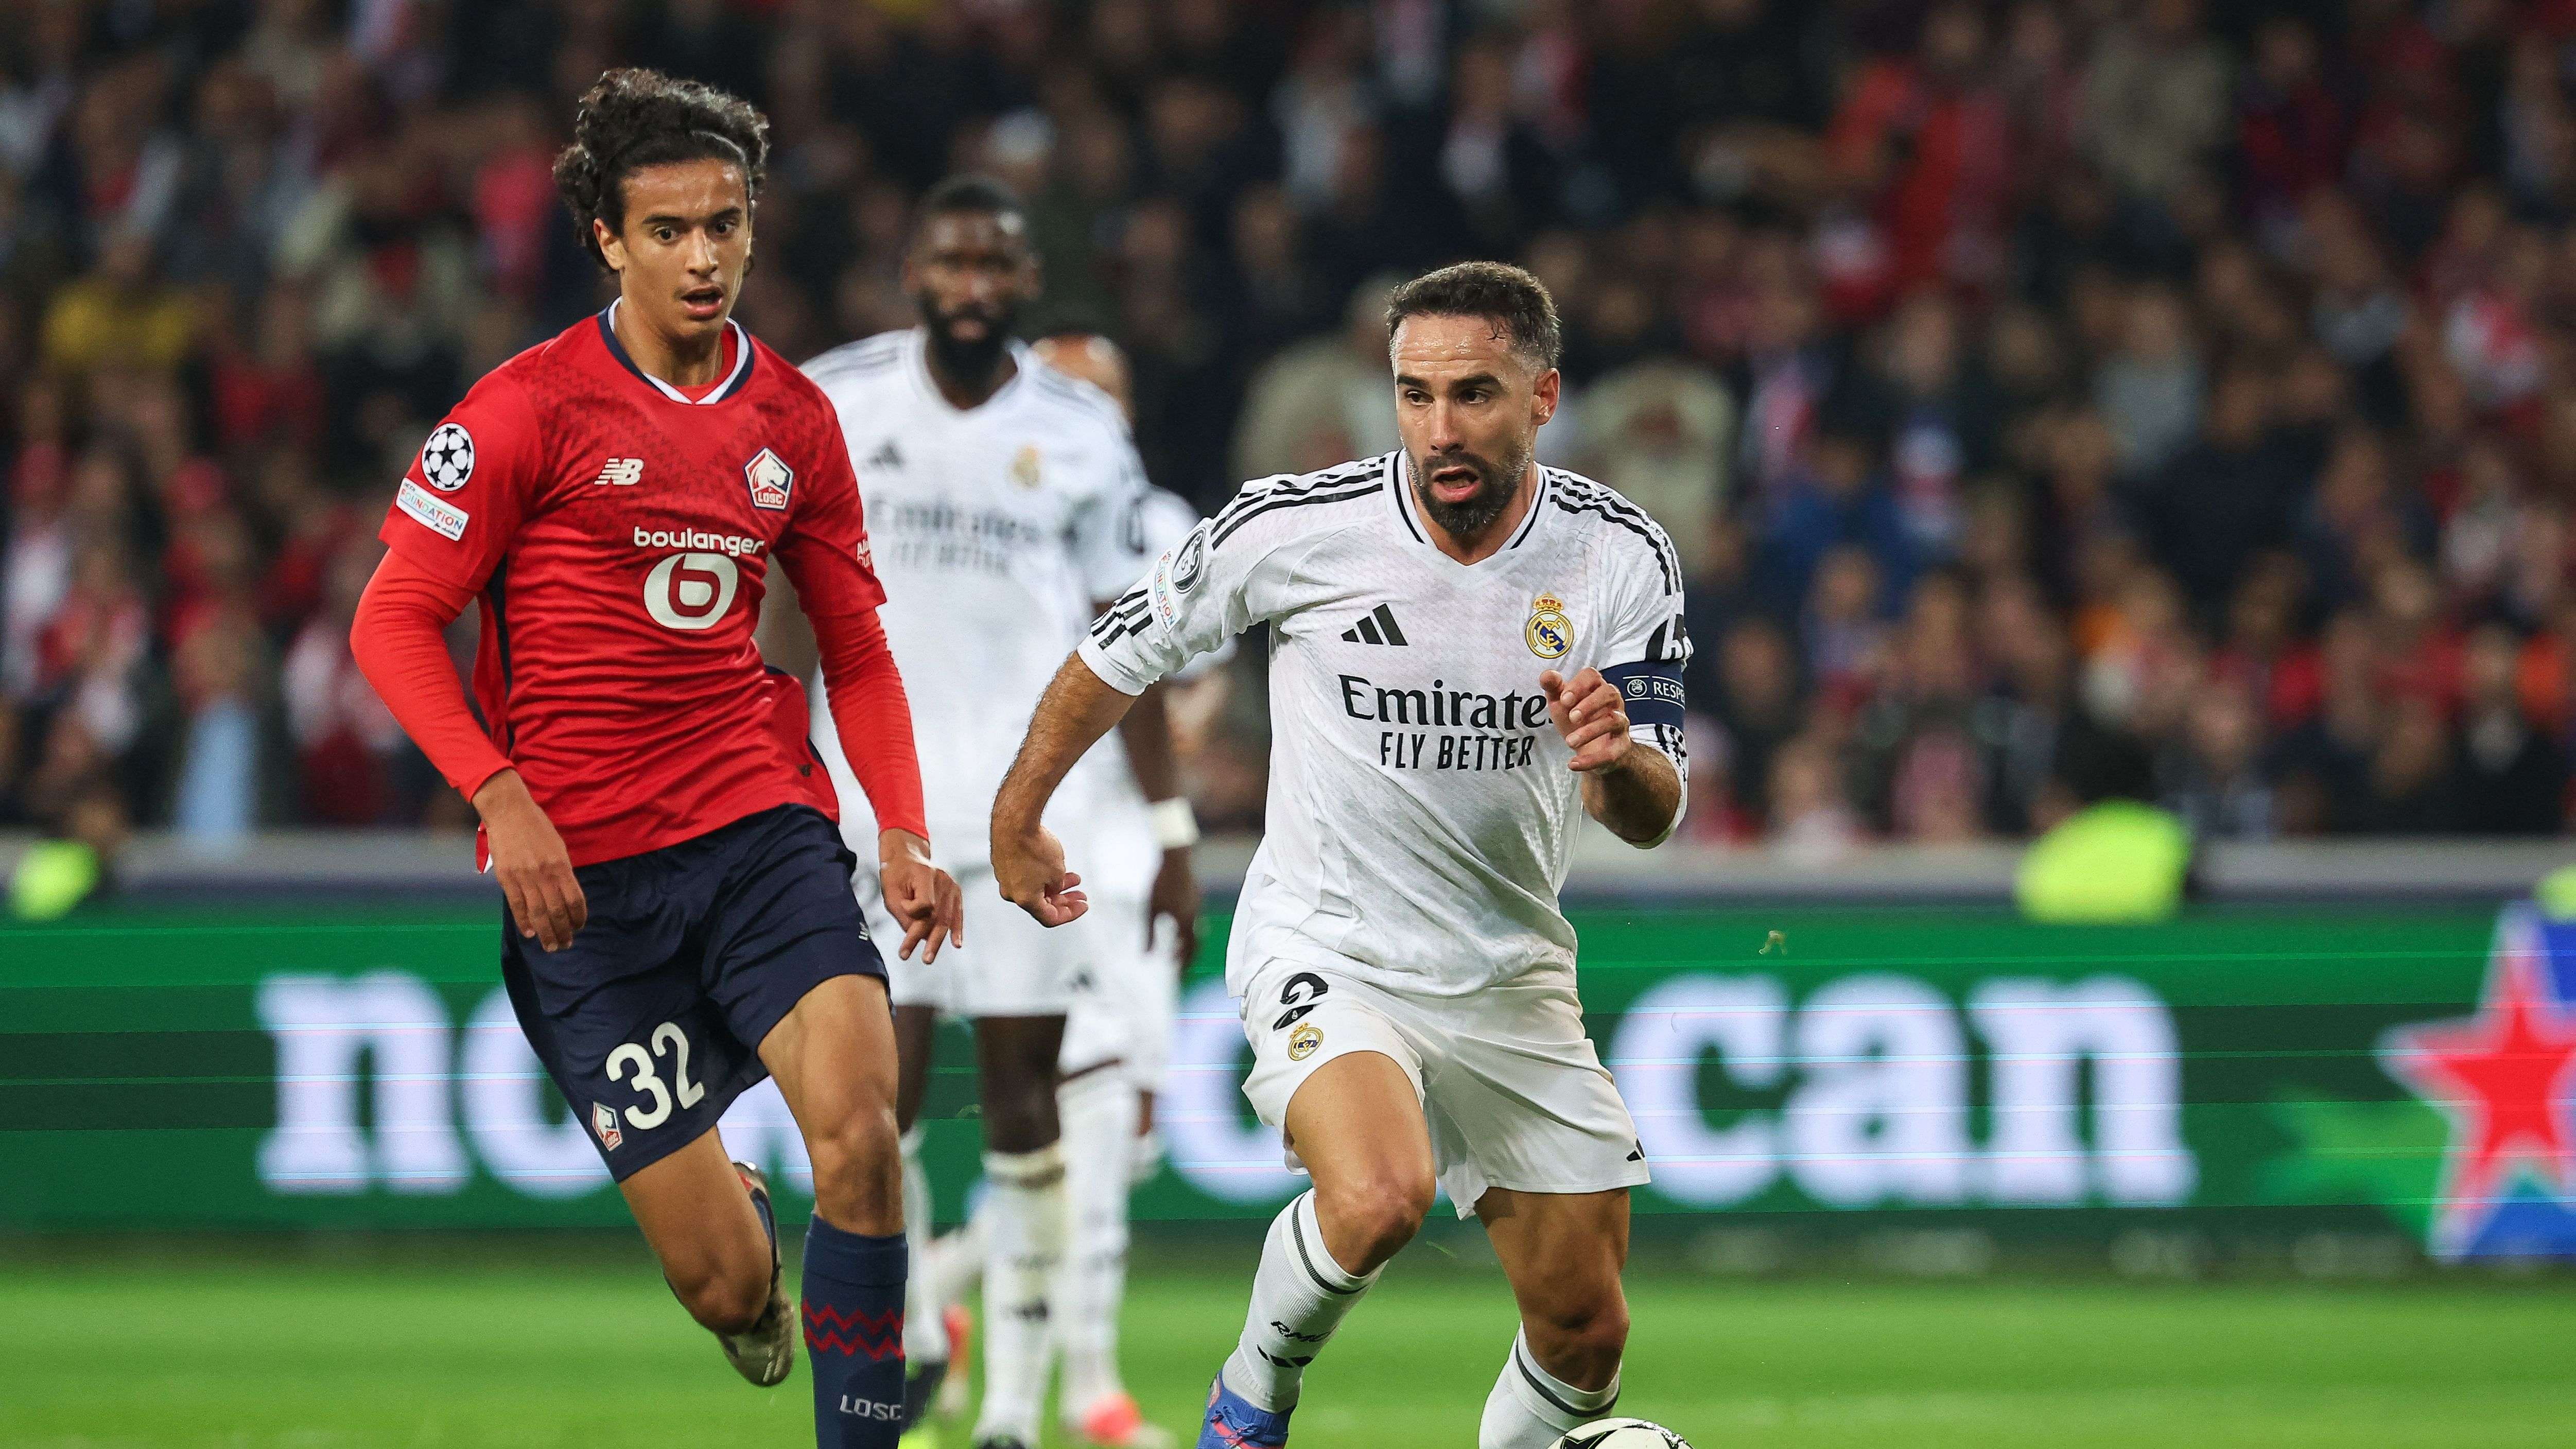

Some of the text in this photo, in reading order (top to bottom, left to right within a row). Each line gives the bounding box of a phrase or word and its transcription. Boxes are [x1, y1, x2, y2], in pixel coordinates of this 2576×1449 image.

[402, 489, 463, 531] FOUNDATION
[634, 526, 765, 556] boulanger
[1337, 674, 1554, 730] Emirate
[1653, 681, 1685, 703] RESPE
[1381, 731, 1535, 771] FLY BETTER
[606, 1021, 704, 1130] 32
[1609, 970, 2202, 1209] can
[840, 1394, 901, 1421] LOSC
